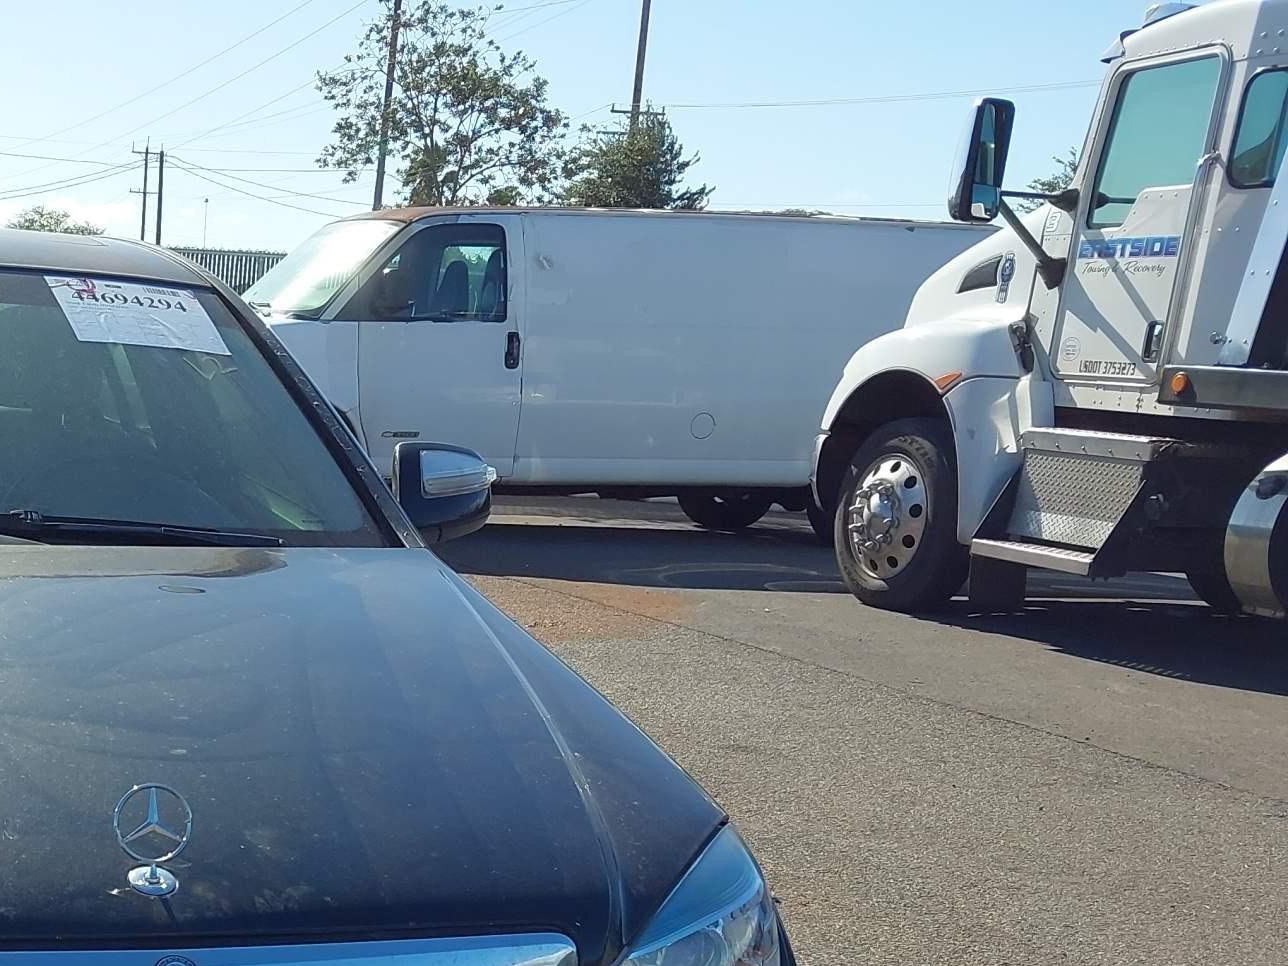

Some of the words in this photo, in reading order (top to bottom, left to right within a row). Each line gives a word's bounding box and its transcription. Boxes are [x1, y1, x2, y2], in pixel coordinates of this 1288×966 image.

[1079, 237, 1179, 258] EASTSIDE
[1082, 262, 1110, 276] Towing
[1123, 261, 1167, 277] Recovery
[71, 290, 187, 313] 44694294
[1103, 361, 1136, 376] 3753273
